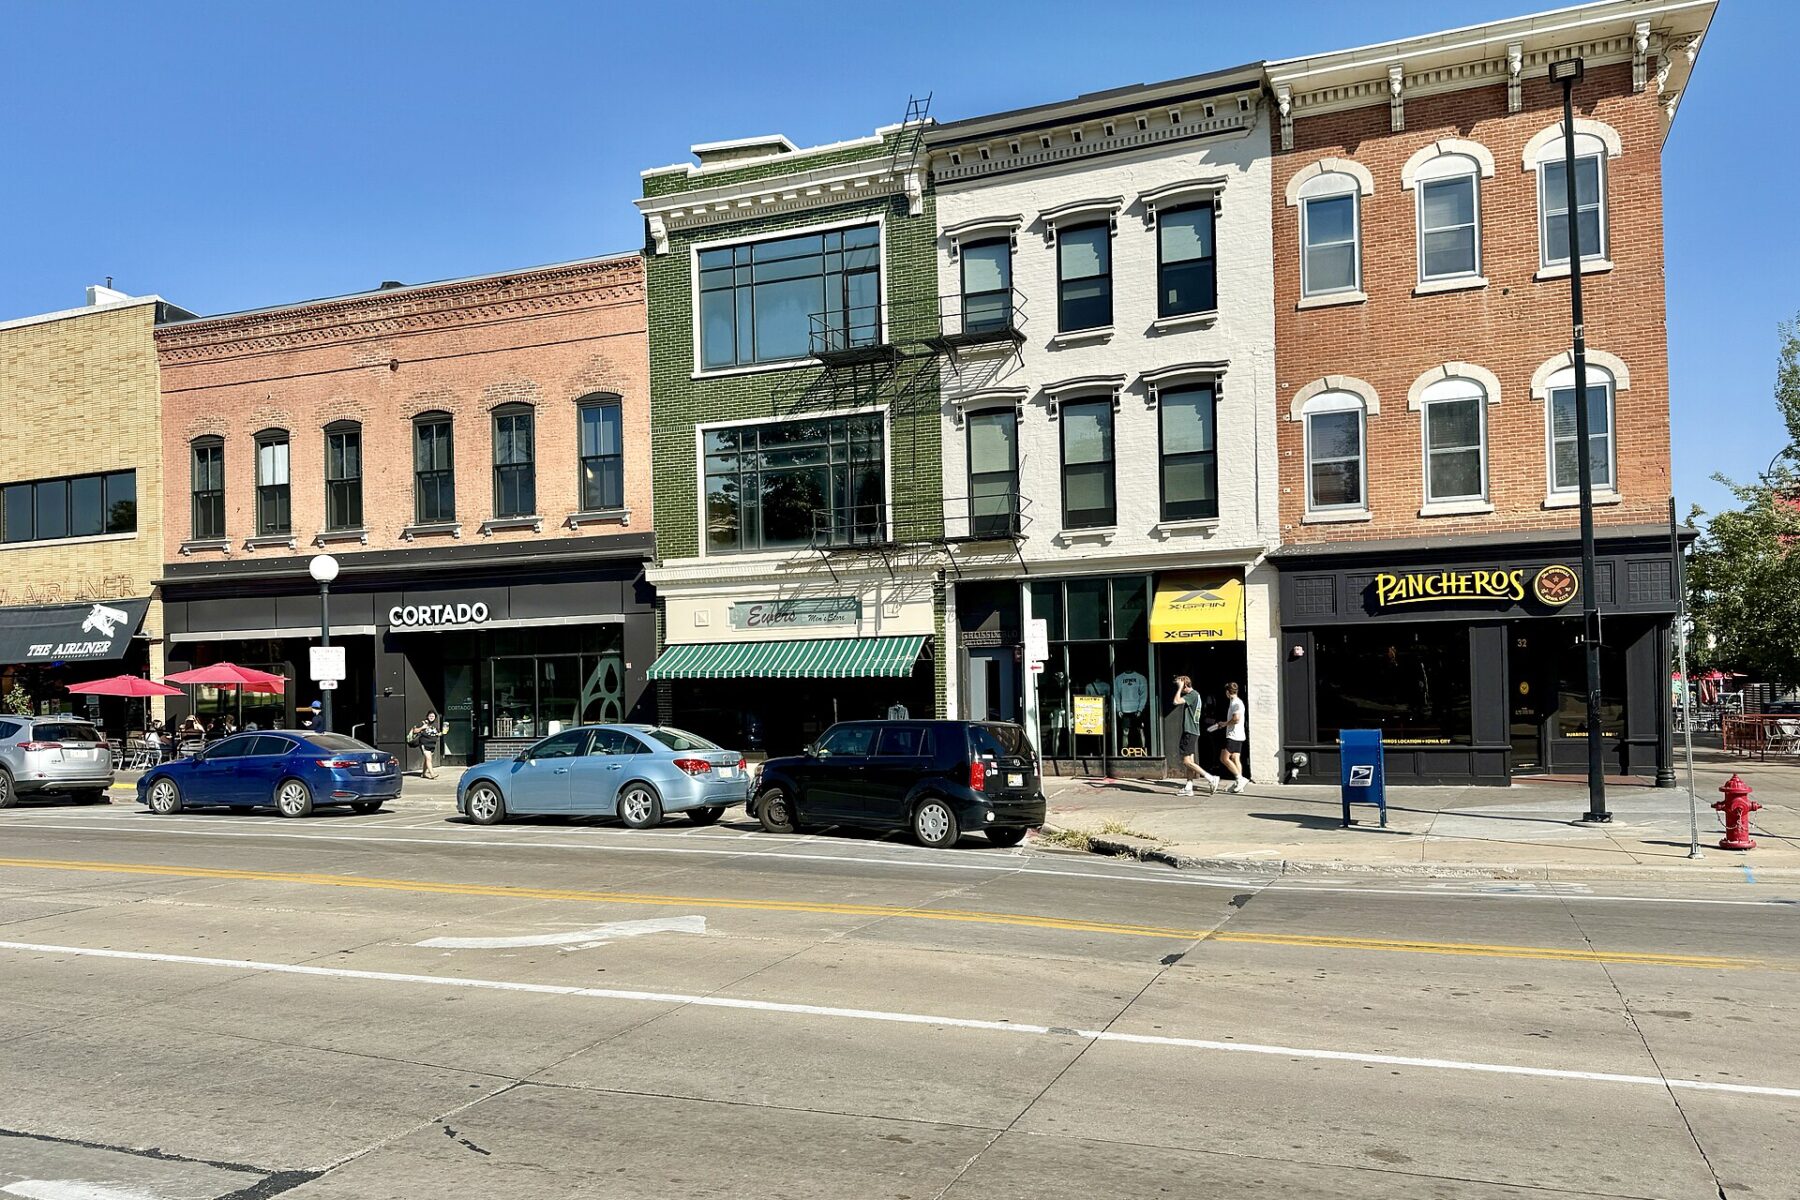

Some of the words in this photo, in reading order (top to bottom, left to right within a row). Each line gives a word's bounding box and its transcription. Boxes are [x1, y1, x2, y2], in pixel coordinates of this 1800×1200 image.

[1375, 570, 1525, 606] PANCHEROS
[389, 602, 489, 626] CORTADO
[747, 605, 797, 627] Ewers
[27, 644, 53, 656] THE
[52, 641, 112, 655] AIRLINER
[1517, 638, 1527, 648] 32
[1121, 747, 1148, 757] OPEN
